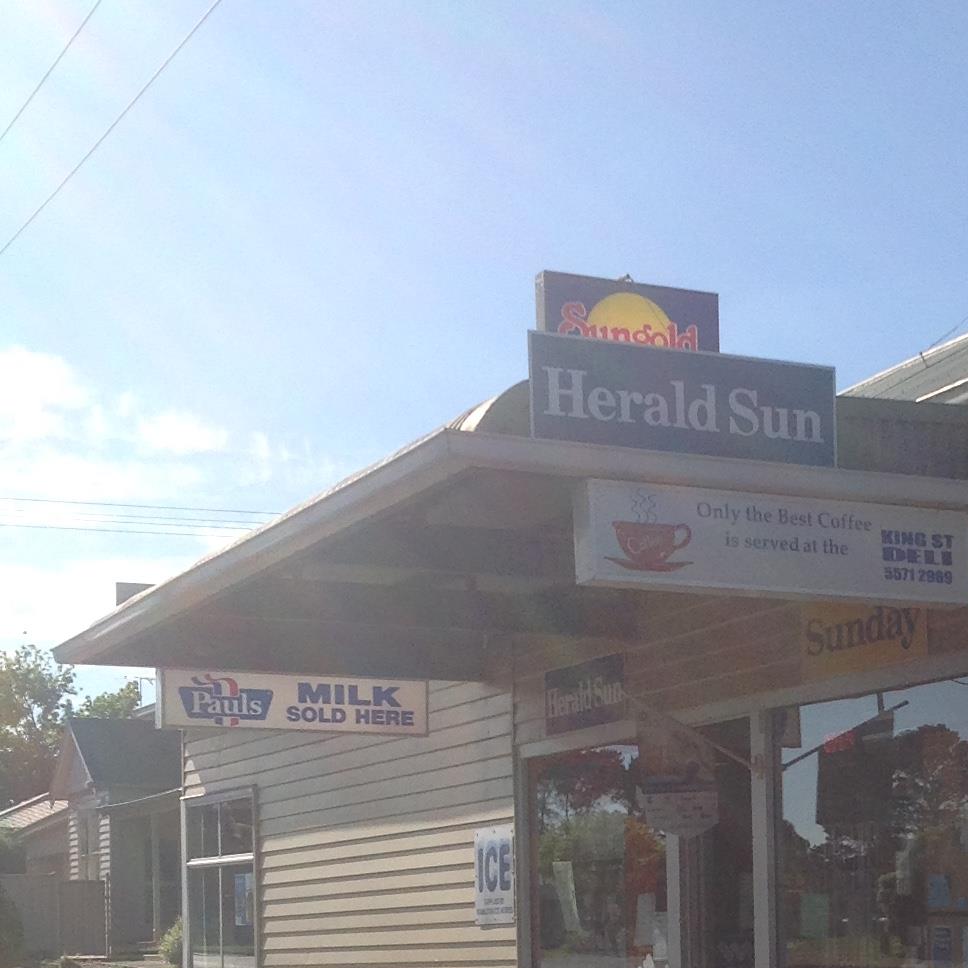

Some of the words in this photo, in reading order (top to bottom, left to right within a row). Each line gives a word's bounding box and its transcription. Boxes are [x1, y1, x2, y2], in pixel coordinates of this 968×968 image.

[542, 366, 720, 433] Herald
[729, 388, 824, 443] Sun
[696, 501, 741, 525] Only
[746, 505, 772, 523] the
[778, 508, 812, 528] Best
[817, 512, 873, 532] Coffee
[724, 531, 739, 548] is
[744, 536, 799, 552] served
[803, 540, 818, 554] at
[822, 539, 849, 556] the
[881, 529, 927, 548] KING
[931, 533, 955, 549] ST
[882, 547, 953, 566] DELI
[806, 605, 921, 656] Sunday
[191, 690, 263, 716] Pauls
[297, 682, 402, 707] MILK
[546, 679, 592, 718] Herald
[286, 705, 346, 723] SOLD
[355, 709, 415, 726] HERE
[478, 840, 511, 893] ICE
